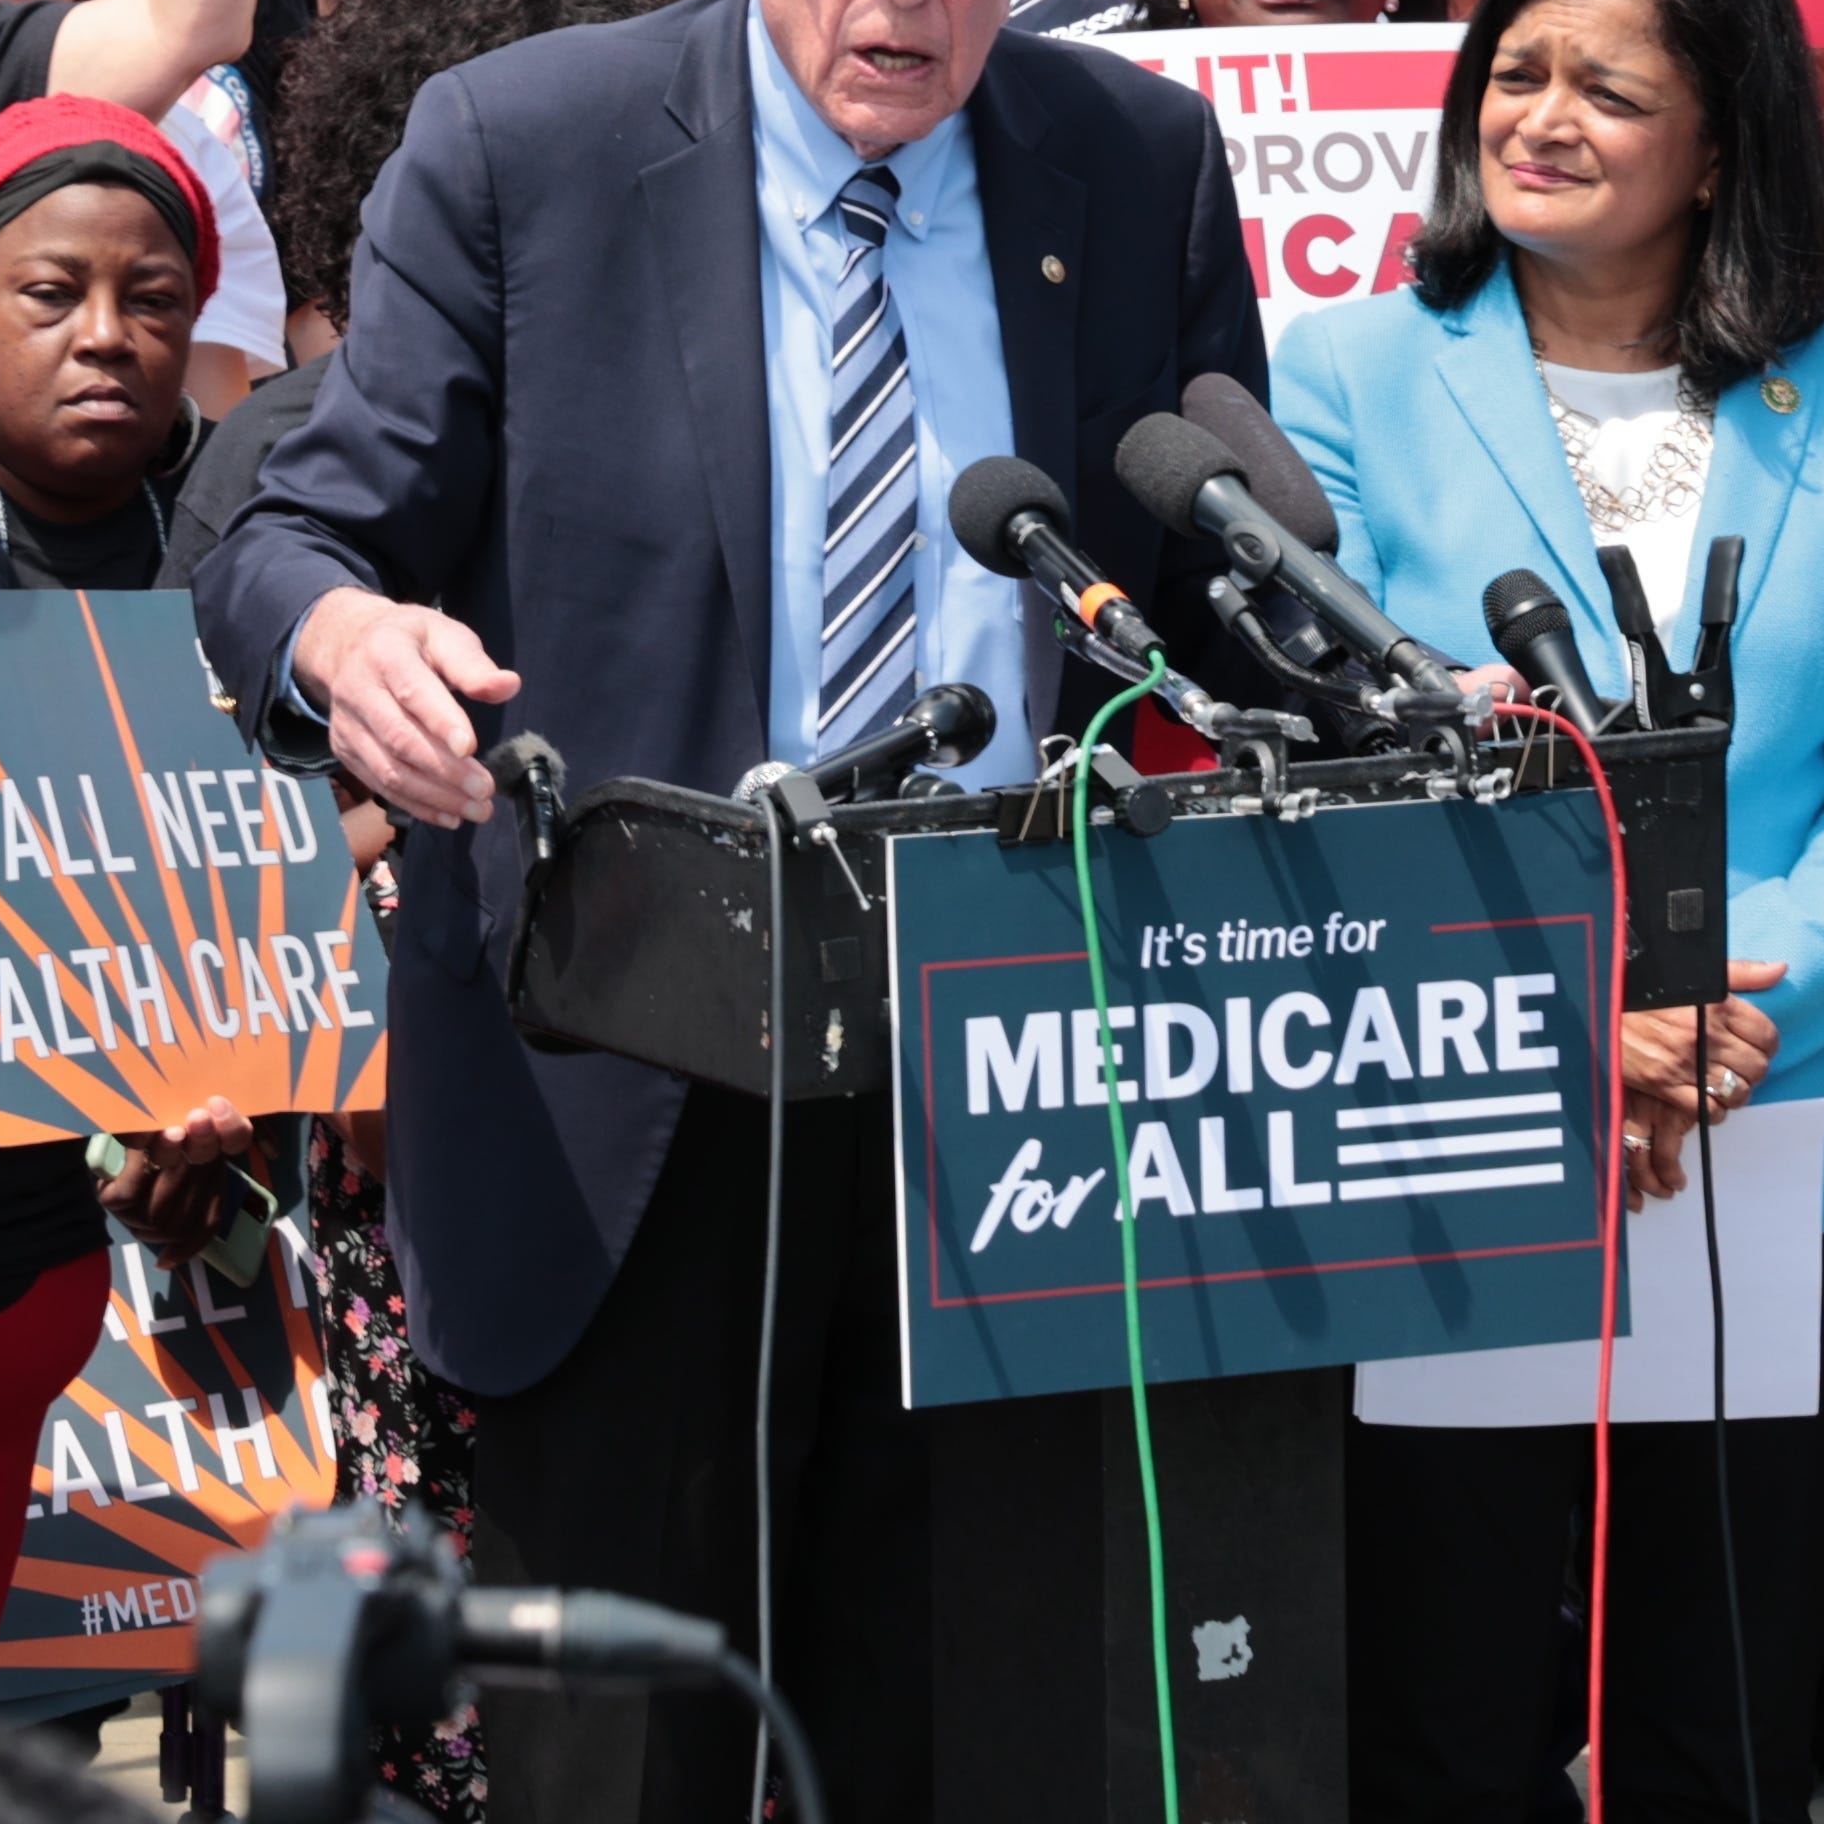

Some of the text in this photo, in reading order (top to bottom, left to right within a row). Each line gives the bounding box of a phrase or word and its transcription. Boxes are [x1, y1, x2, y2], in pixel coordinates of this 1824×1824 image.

[1, 774, 136, 881] ALL
[140, 768, 318, 868] NEED
[188, 929, 374, 1040] CARE
[1140, 912, 1386, 969] It's time for
[965, 973, 1560, 1115] MEDICARE
[969, 1110, 1332, 1253] for ALL
[26, 1386, 279, 1519] ALTH
